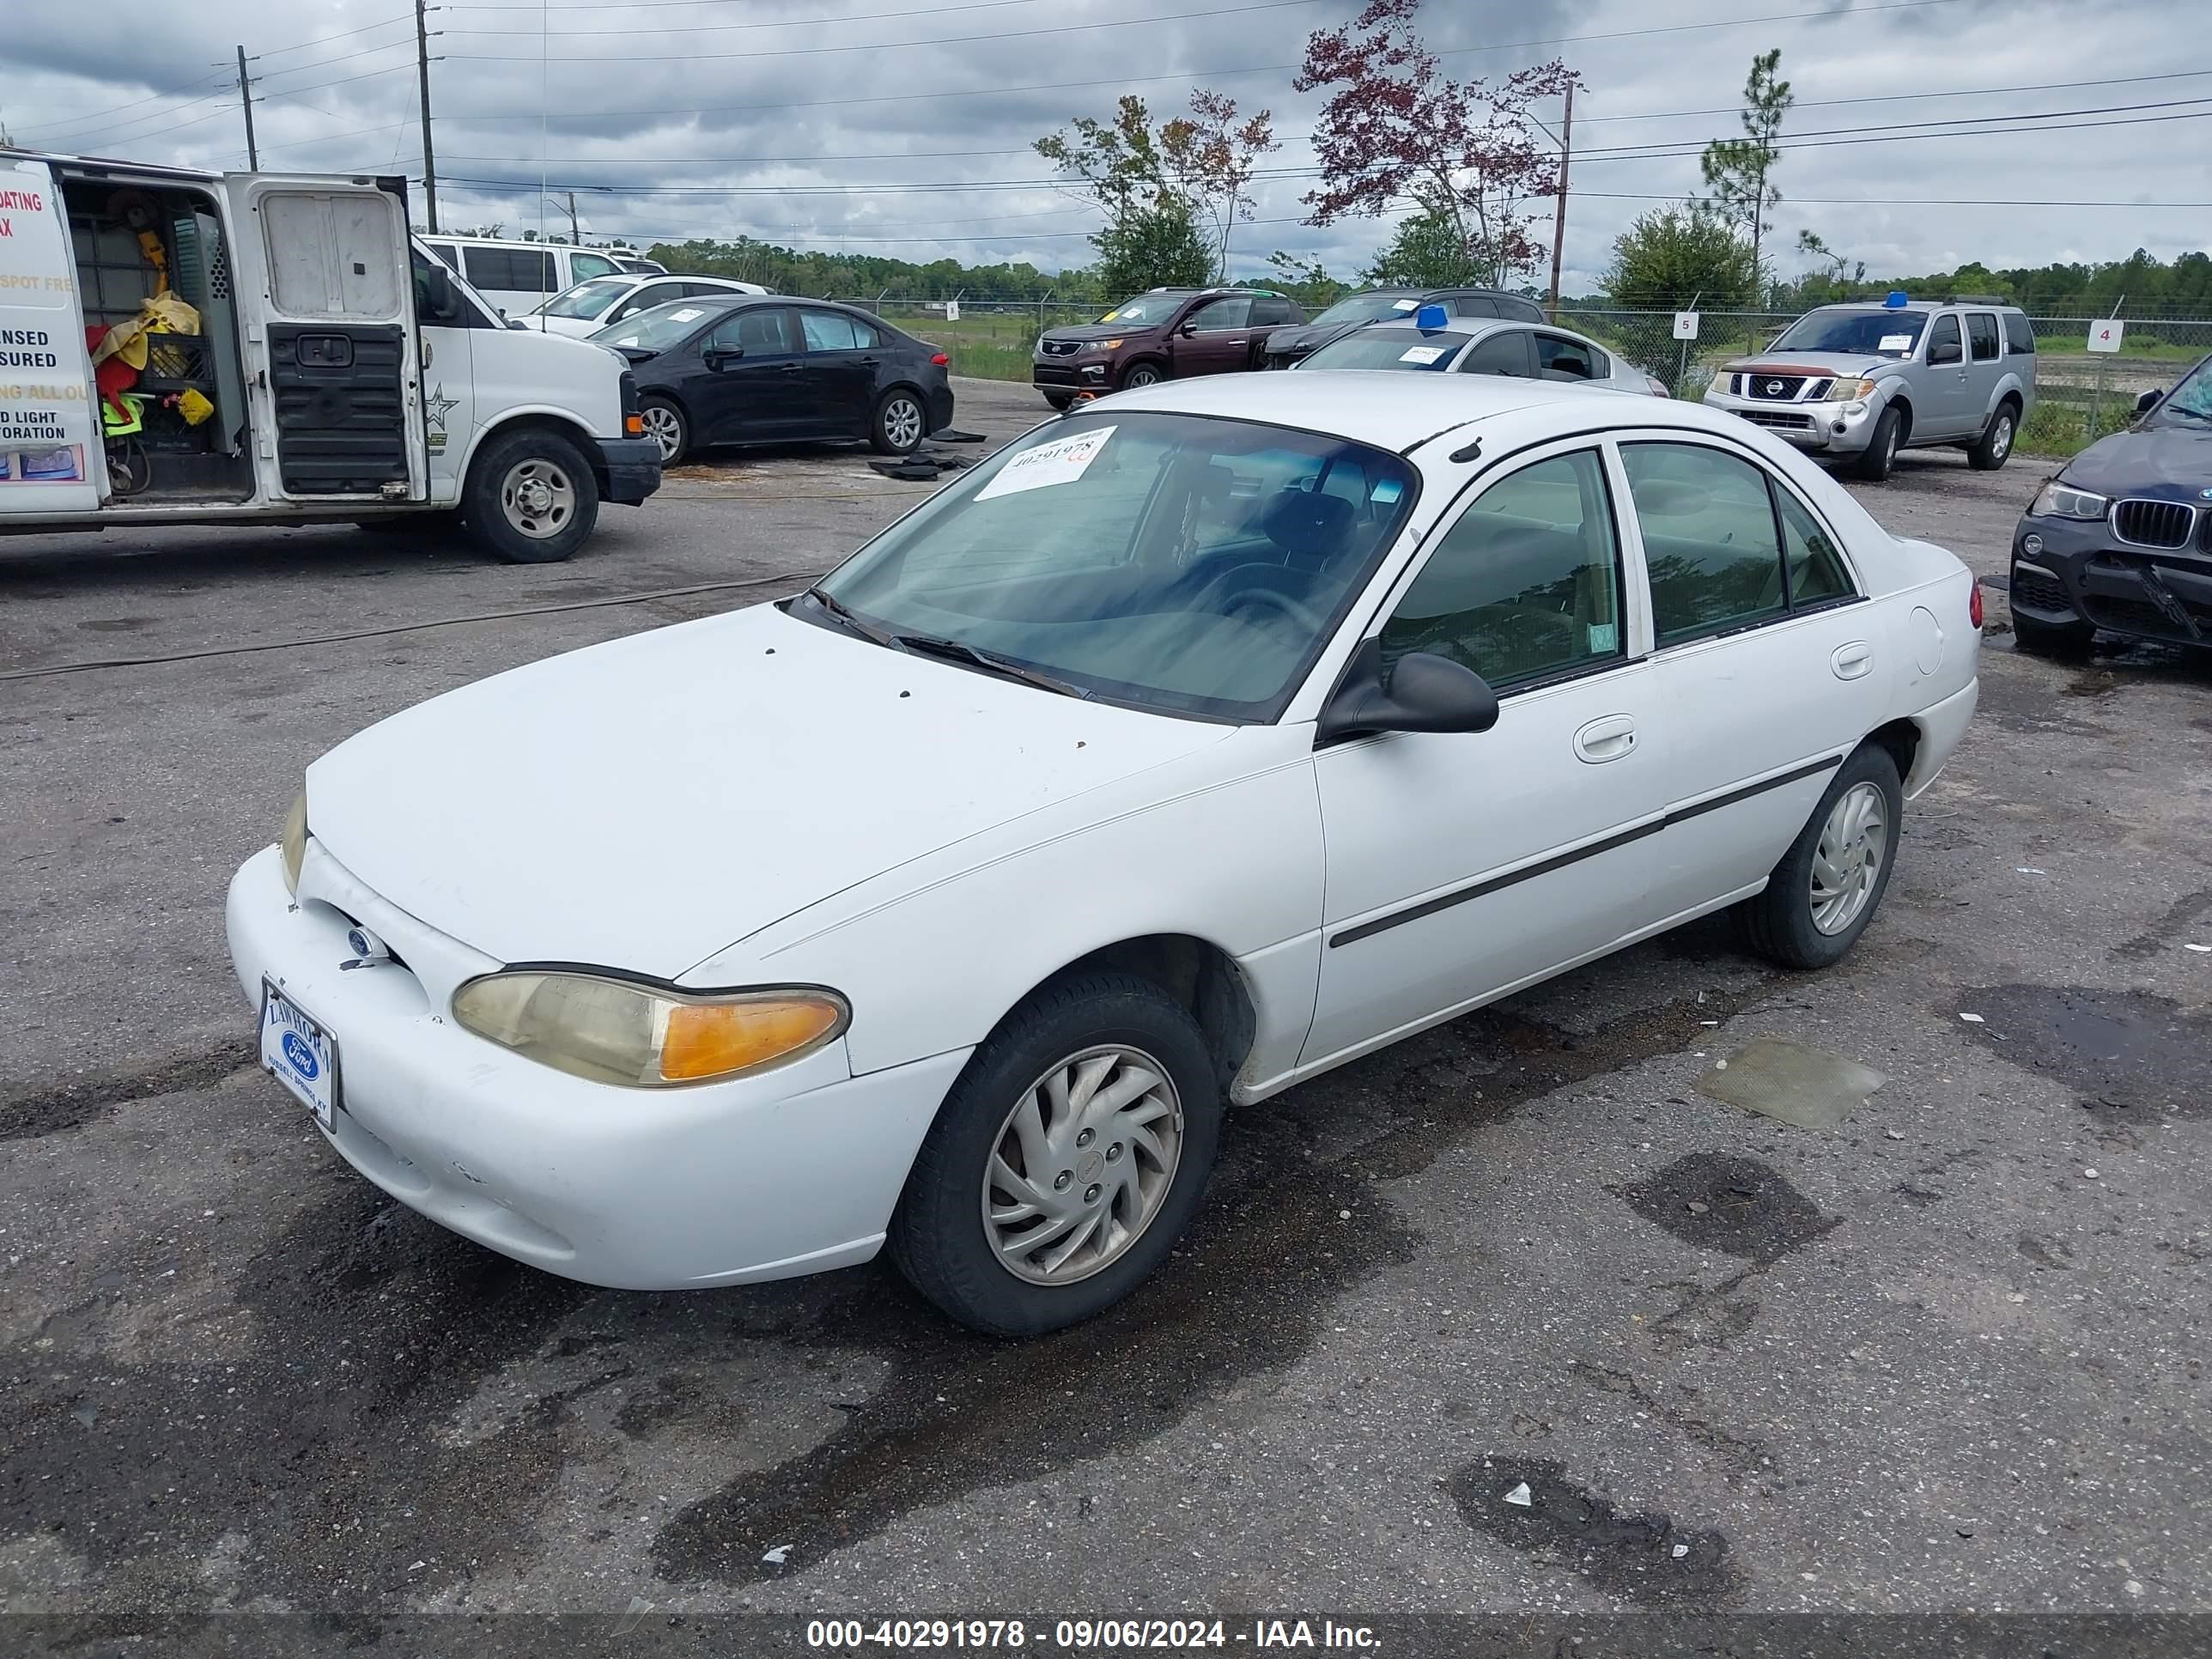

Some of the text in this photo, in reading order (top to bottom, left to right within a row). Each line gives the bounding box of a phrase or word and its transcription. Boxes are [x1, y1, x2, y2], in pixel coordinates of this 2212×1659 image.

[0, 275, 39, 289] SPOT
[1682, 320, 1689, 330] 5
[0, 330, 49, 346] NSED
[2100, 330, 2111, 341] 4
[0, 351, 57, 368] SURED
[29, 385, 62, 400] ALL
[1, 411, 58, 424] D LIGHT
[0, 427, 65, 439] ORATION
[1012, 440, 1095, 468] 40291978
[288, 1036, 312, 1073] Ford
[268, 1053, 294, 1080] RUSSELL
[317, 1099, 327, 1111] KY
